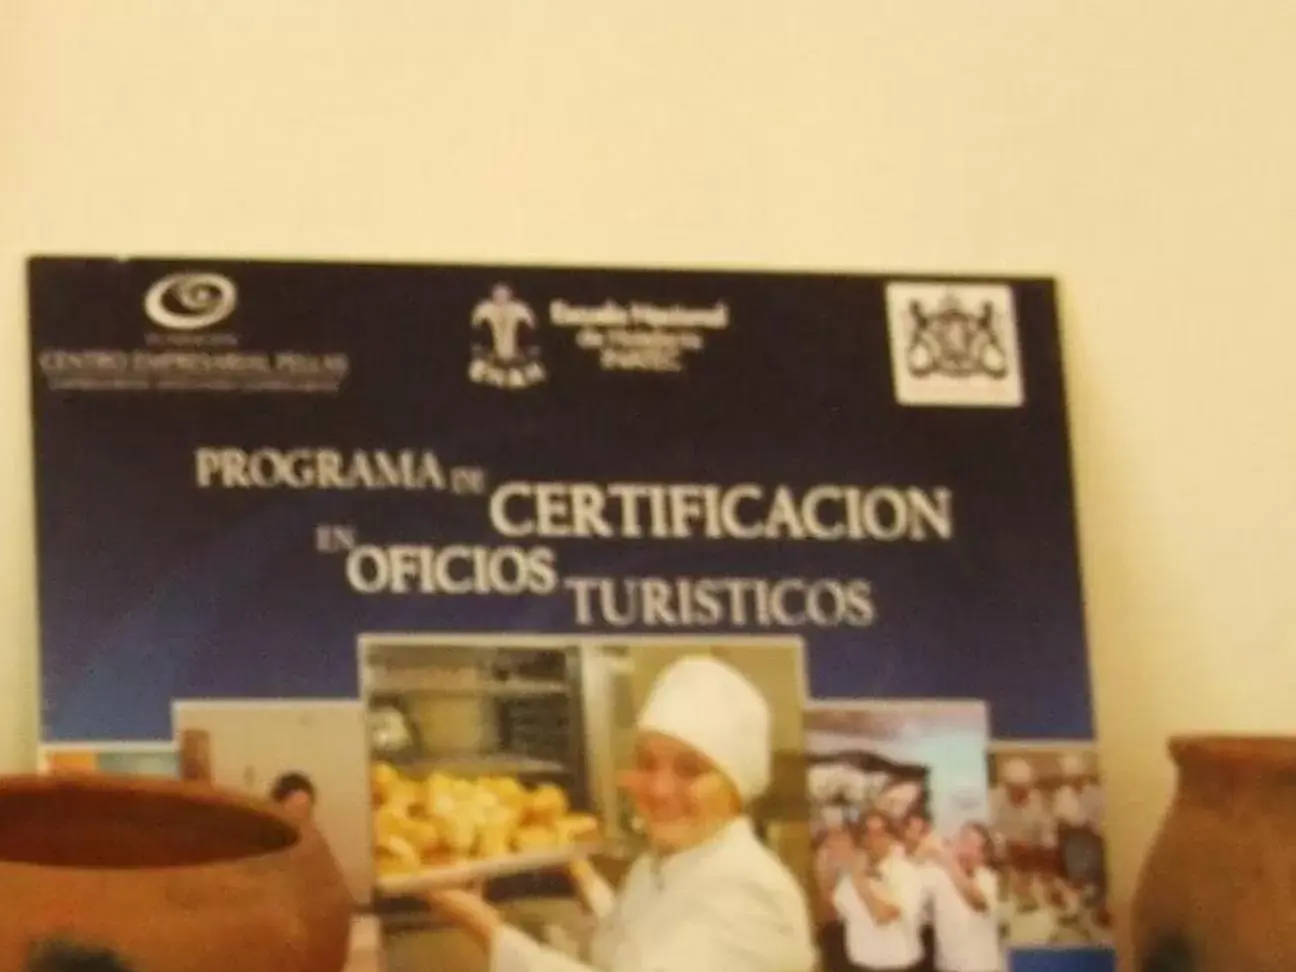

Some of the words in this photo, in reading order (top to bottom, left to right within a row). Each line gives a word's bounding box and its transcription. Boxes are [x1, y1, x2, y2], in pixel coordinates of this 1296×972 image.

[194, 447, 444, 490] PROGRAMA
[449, 467, 486, 495] DE
[489, 482, 954, 541] CERTIFICACION
[315, 525, 356, 553] EN
[345, 545, 556, 595] OFICIOS
[565, 575, 875, 628] TURISTICOS
